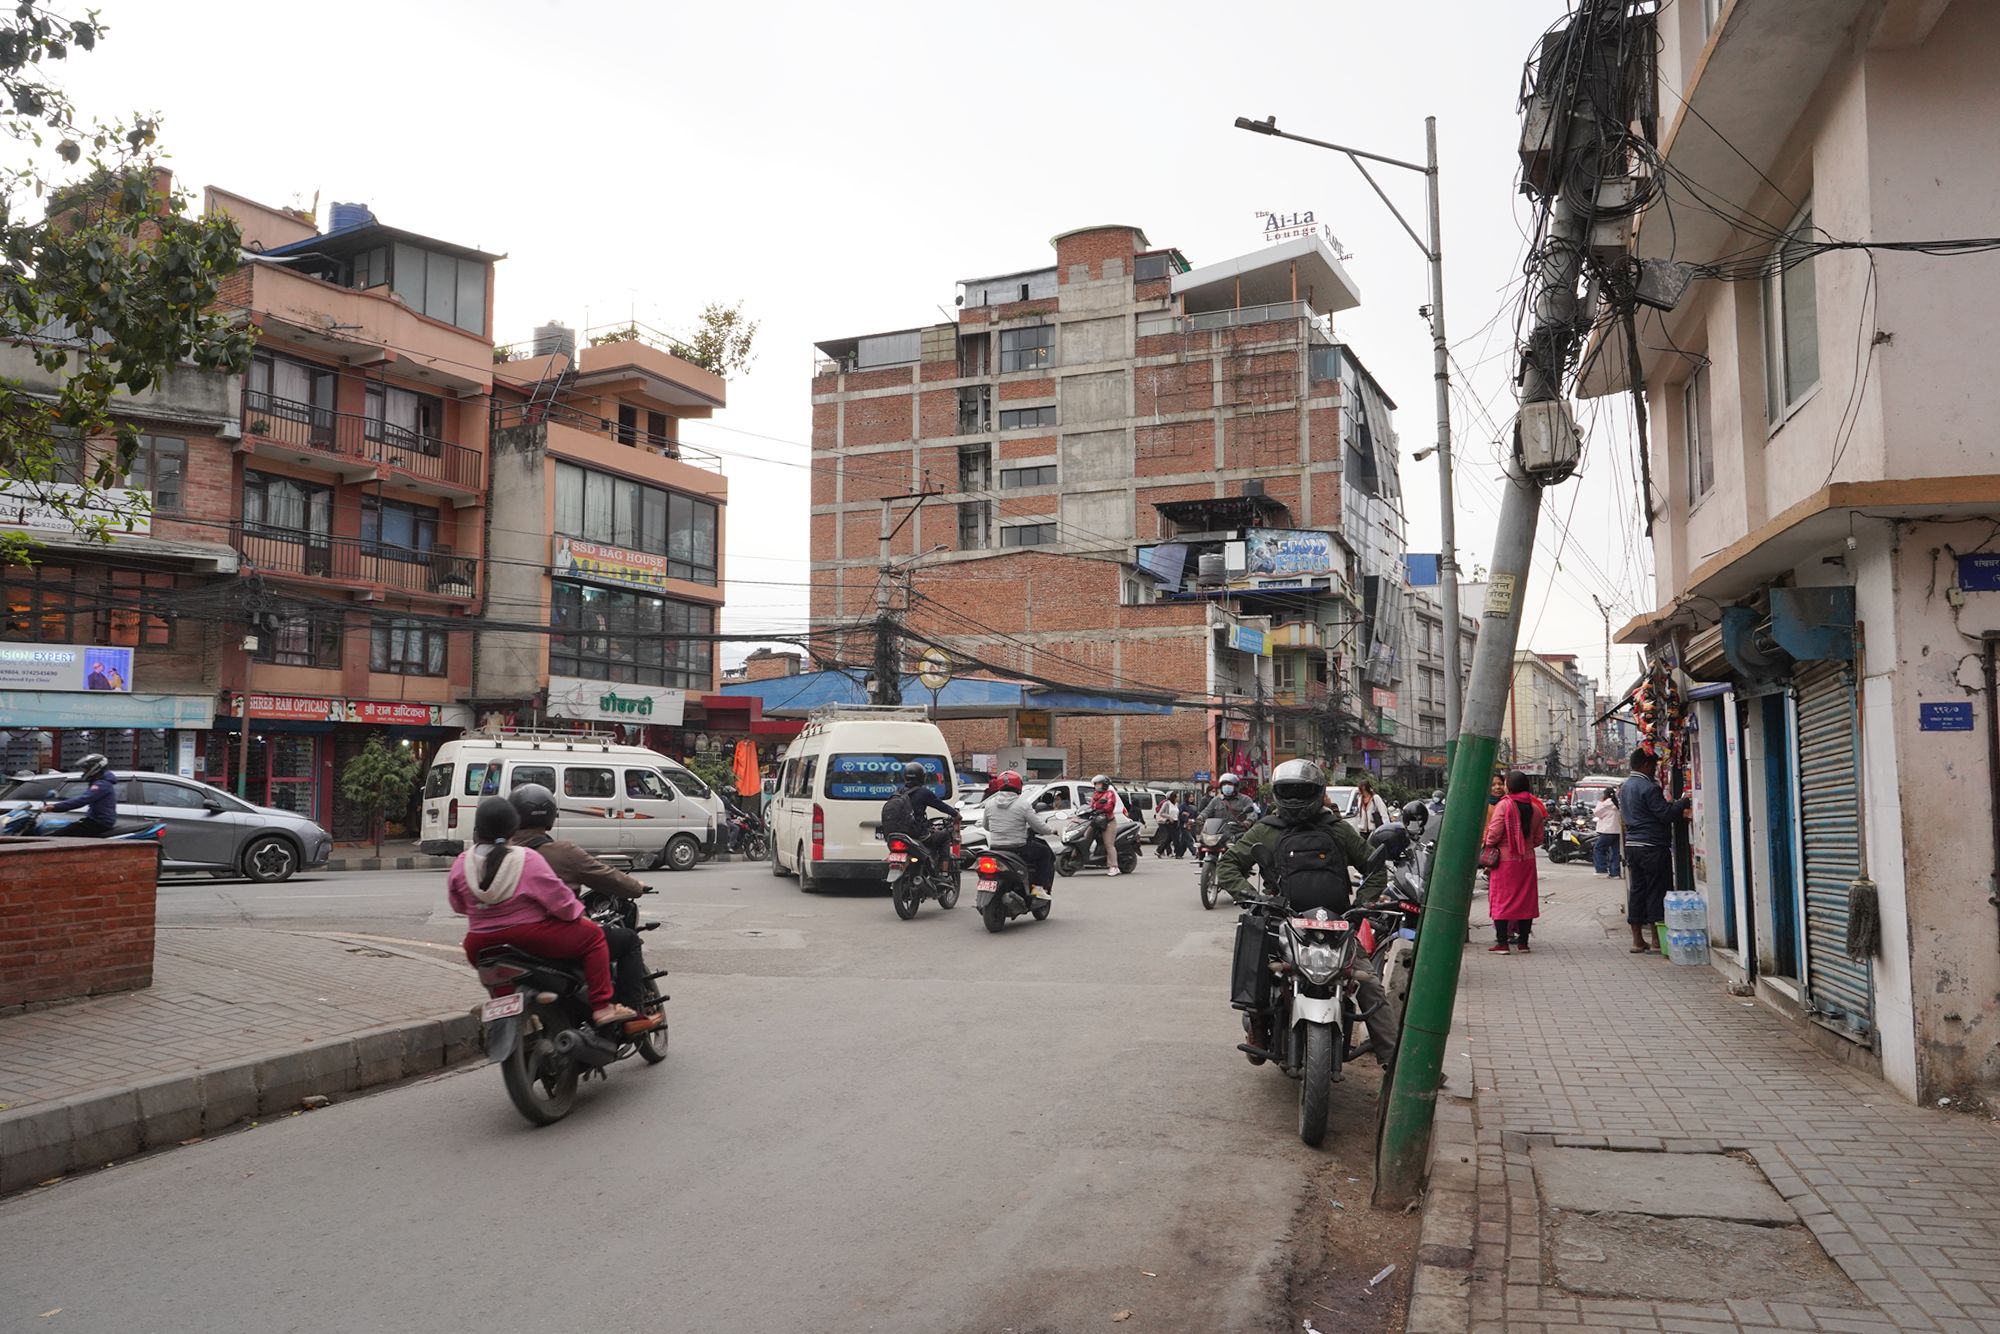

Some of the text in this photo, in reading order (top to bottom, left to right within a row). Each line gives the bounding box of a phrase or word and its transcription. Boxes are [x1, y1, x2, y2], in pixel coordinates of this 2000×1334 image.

[1265, 210, 1315, 231] Ai-La
[1266, 226, 1317, 241] Lounge
[572, 541, 596, 555] SSD
[599, 547, 623, 561] BAG
[626, 551, 664, 568] HOUSE
[34, 651, 75, 662] EXPERT
[249, 696, 329, 713] SHREE RAM OPTICALS
[377, 705, 391, 716] राम
[856, 761, 908, 772] TOYO
